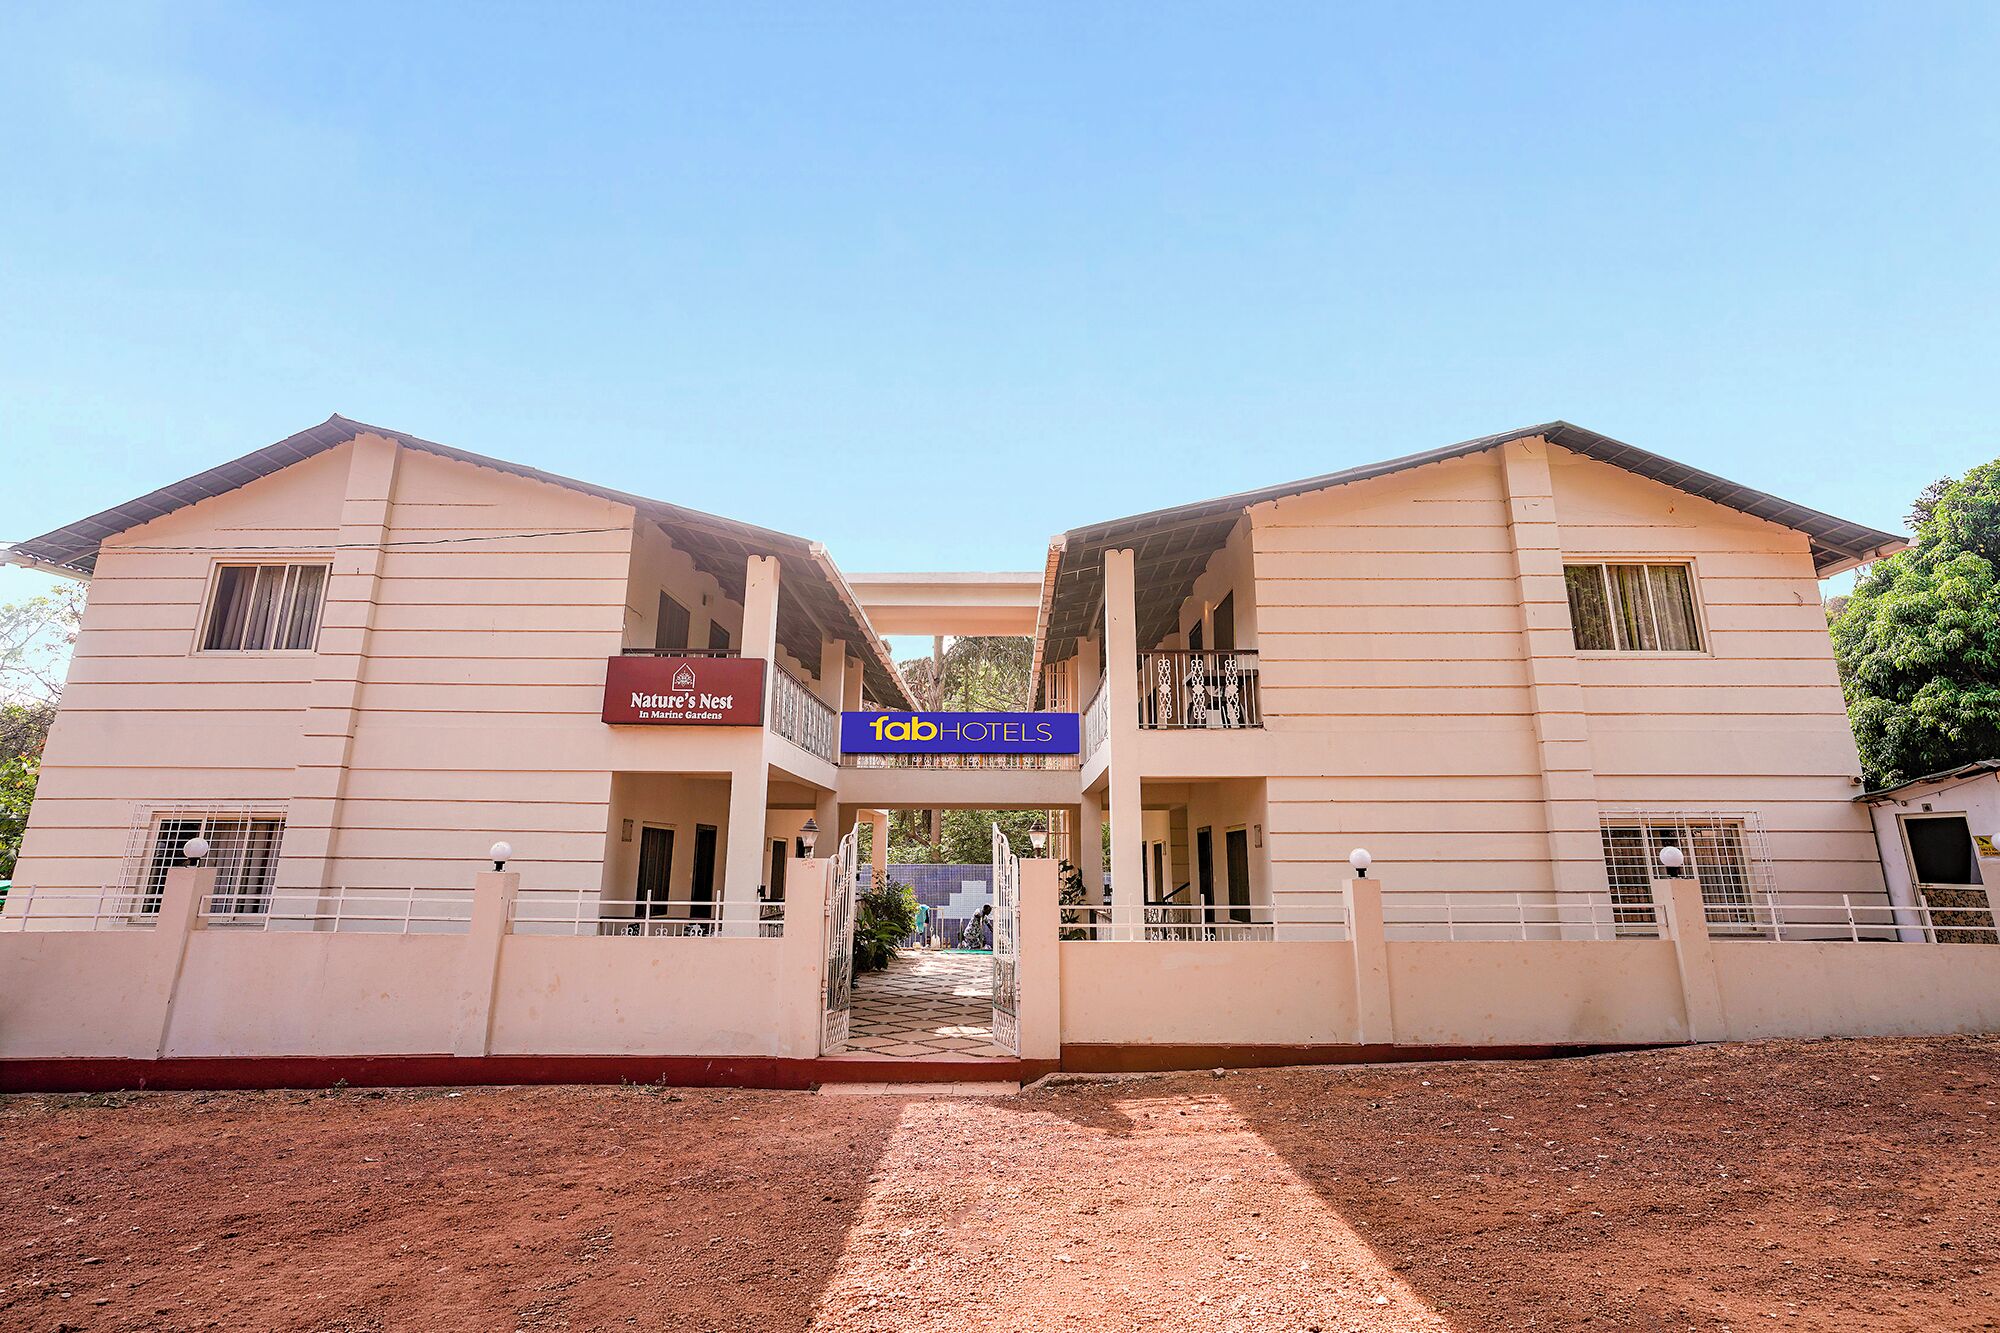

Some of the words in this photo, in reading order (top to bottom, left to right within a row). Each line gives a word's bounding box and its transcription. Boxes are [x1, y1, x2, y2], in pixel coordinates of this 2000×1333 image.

[631, 692, 696, 708] Nature's
[699, 693, 733, 709] Nest
[639, 710, 649, 718] In
[651, 710, 683, 719] Marine
[685, 711, 722, 720] Gardens
